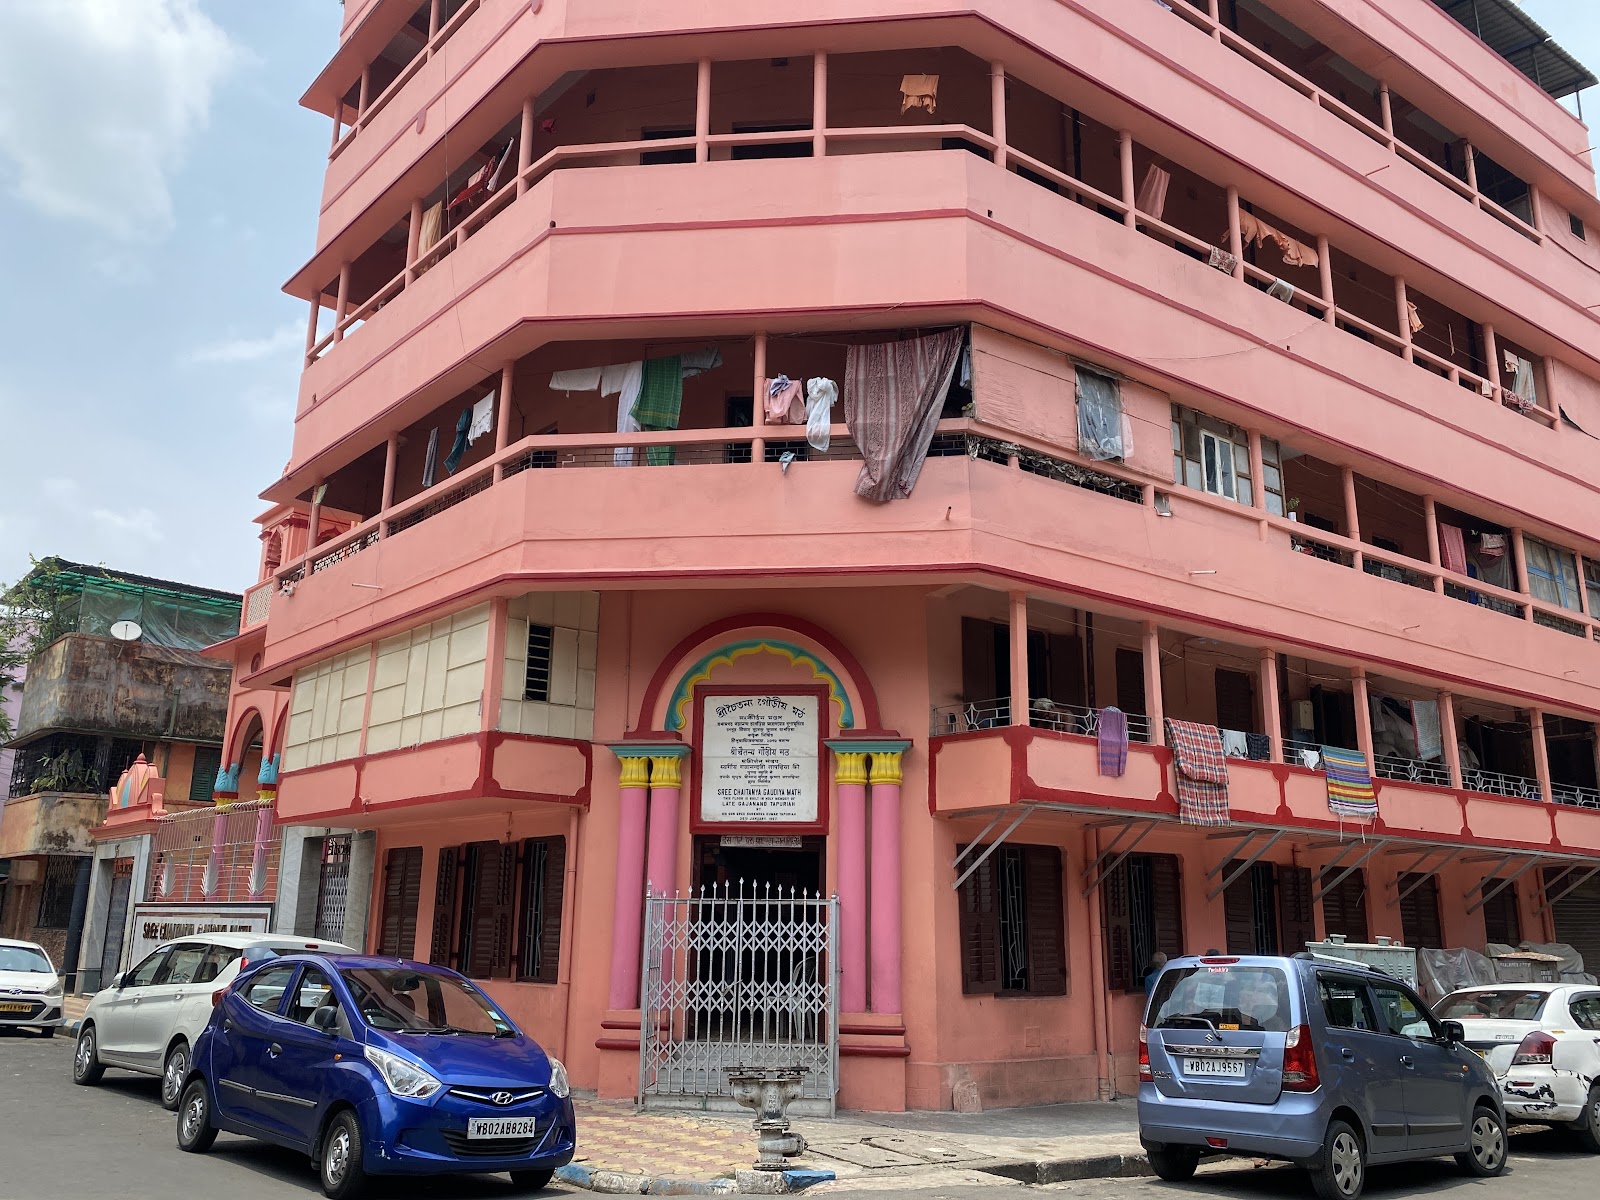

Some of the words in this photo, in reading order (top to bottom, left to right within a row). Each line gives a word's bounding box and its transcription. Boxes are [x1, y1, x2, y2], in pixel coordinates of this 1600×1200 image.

[792, 705, 806, 718] মঠ
[1189, 1060, 1243, 1074] WB02AJ9567
[476, 1121, 534, 1135] WB02AB8284
